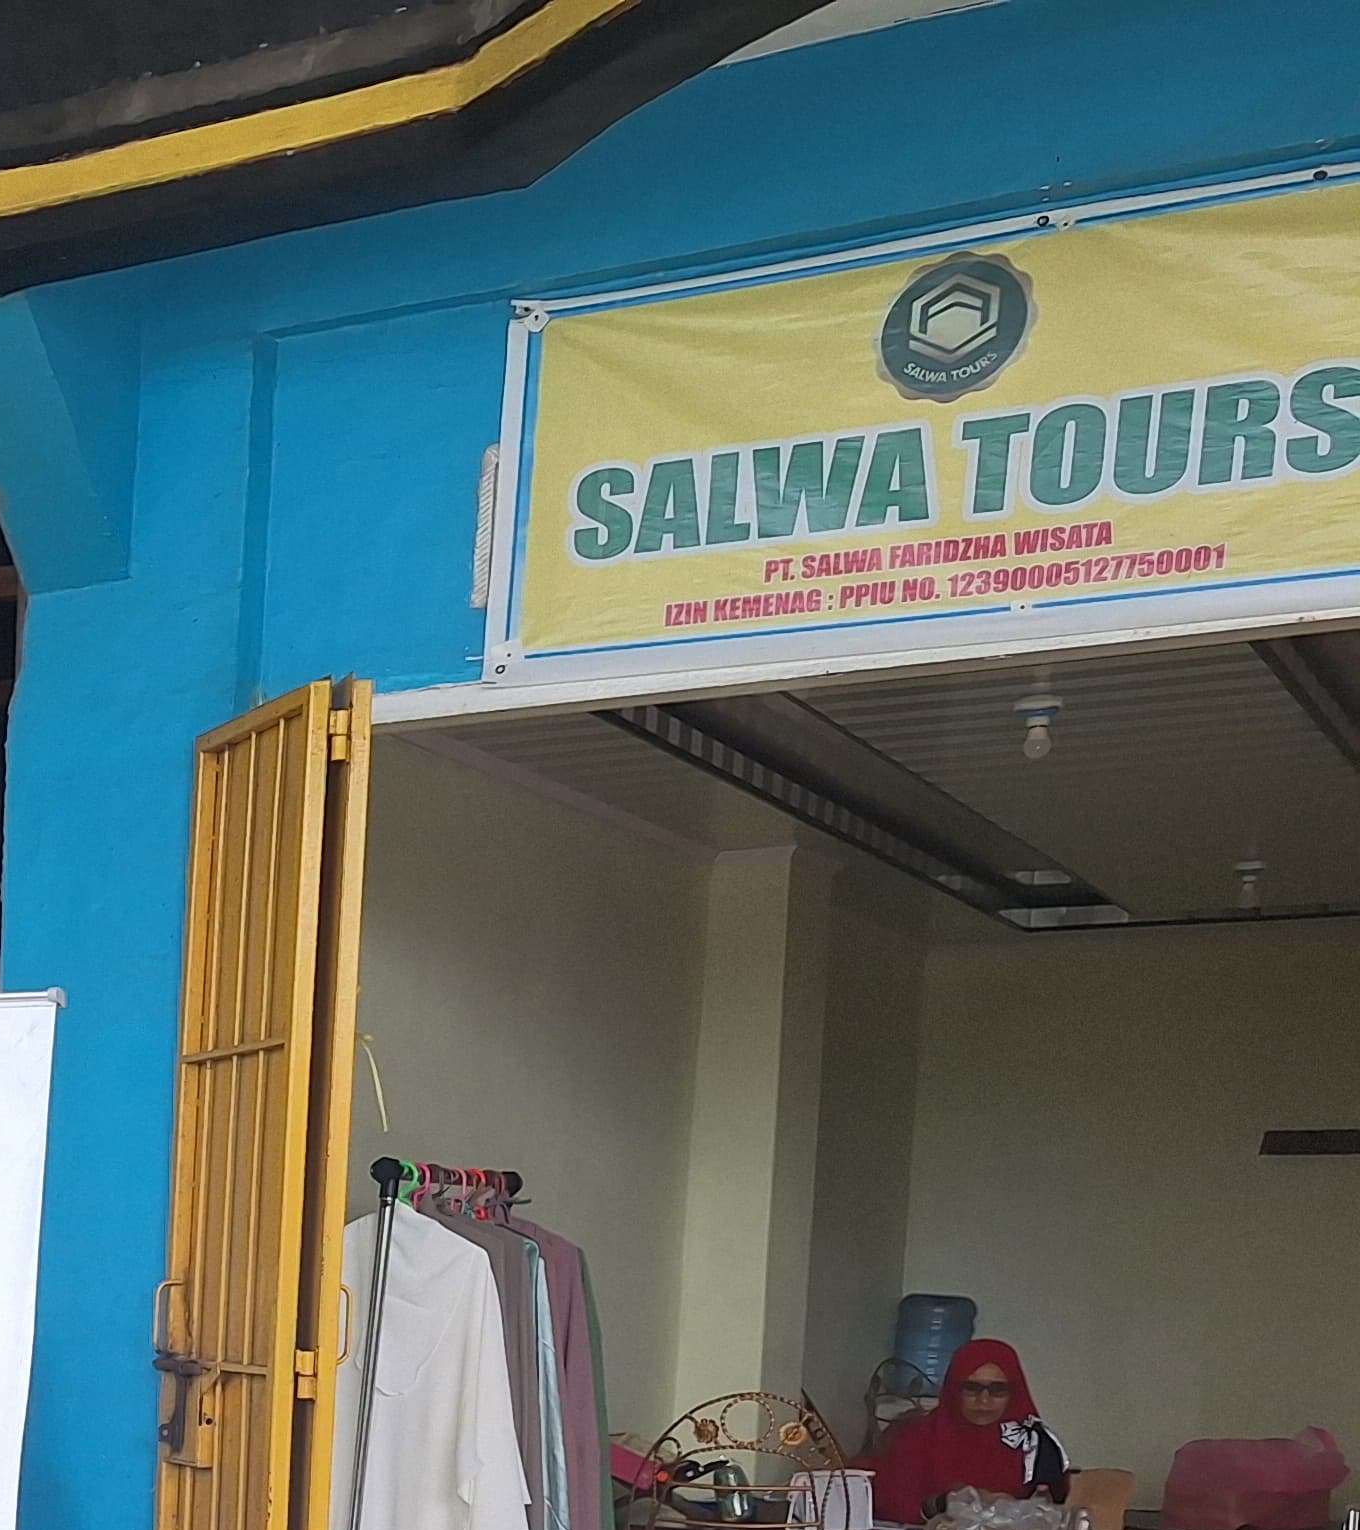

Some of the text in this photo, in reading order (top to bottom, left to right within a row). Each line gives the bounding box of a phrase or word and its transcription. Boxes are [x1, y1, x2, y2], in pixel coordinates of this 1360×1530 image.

[904, 351, 998, 383] SALWA TOURS
[574, 365, 1360, 560] SALWA TOURS
[664, 600, 708, 627] IZIN
[713, 588, 822, 622] KEMENAG
[839, 580, 896, 609] PPIU
[902, 576, 940, 602] NO.
[947, 543, 1227, 598] 12390005127750001
[764, 520, 1112, 583] PT. SALWA FARIDZHA WISATA
